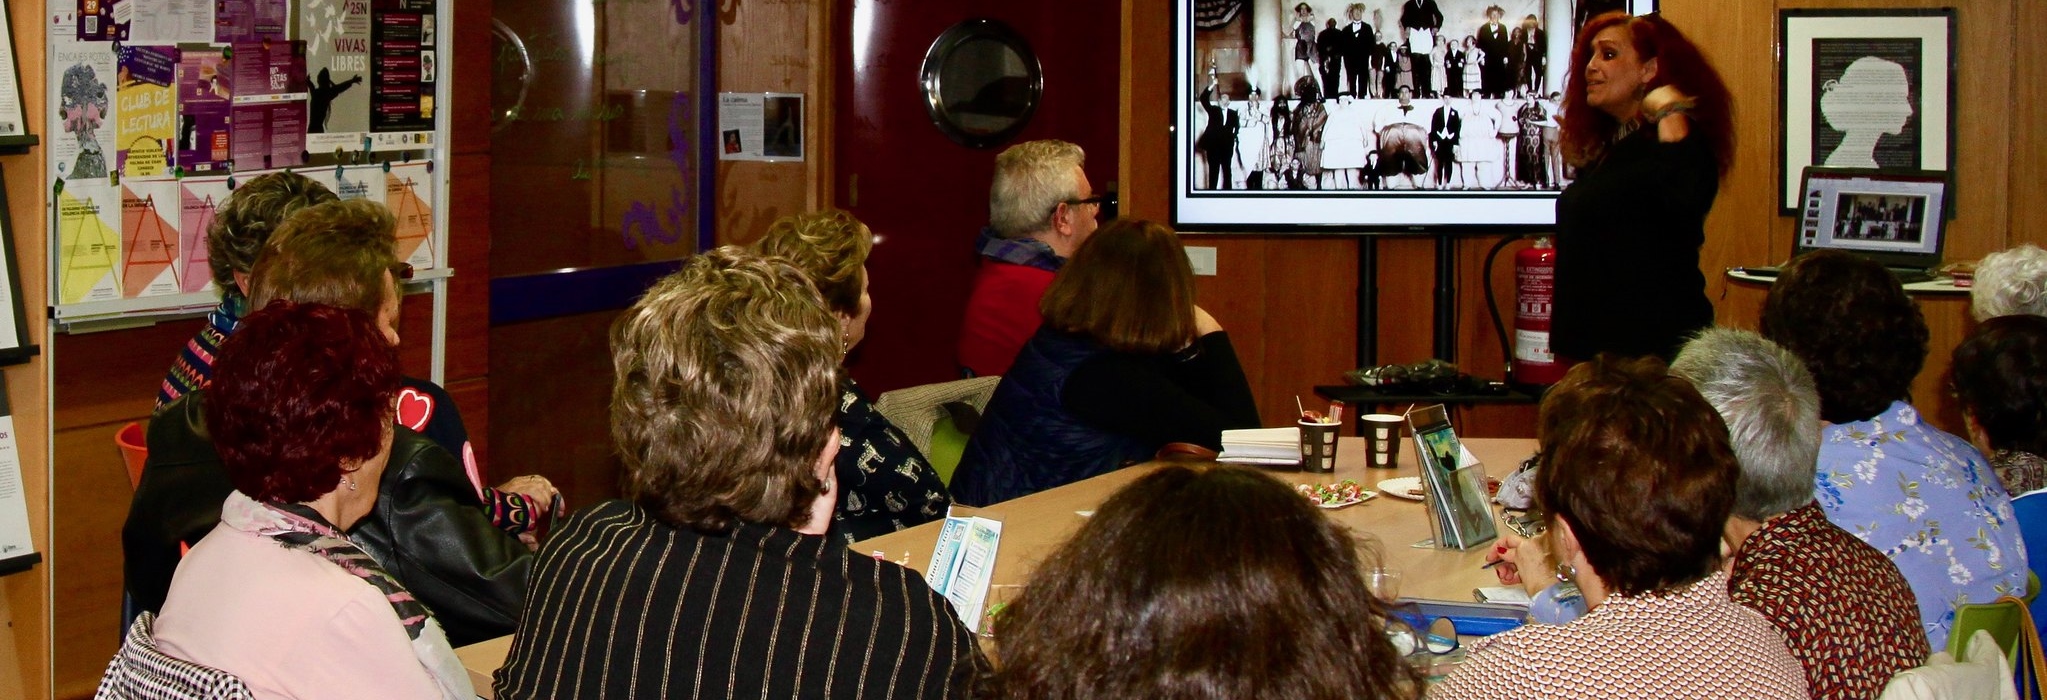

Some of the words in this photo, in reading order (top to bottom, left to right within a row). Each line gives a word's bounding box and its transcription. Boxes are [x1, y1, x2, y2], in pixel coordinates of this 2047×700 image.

[350, 2, 367, 15] 25N
[334, 39, 368, 53] VIVAS,
[331, 55, 366, 72] LIBRES
[121, 92, 151, 112] CLUB
[155, 88, 170, 107] DE
[121, 111, 171, 135] LECTURA
